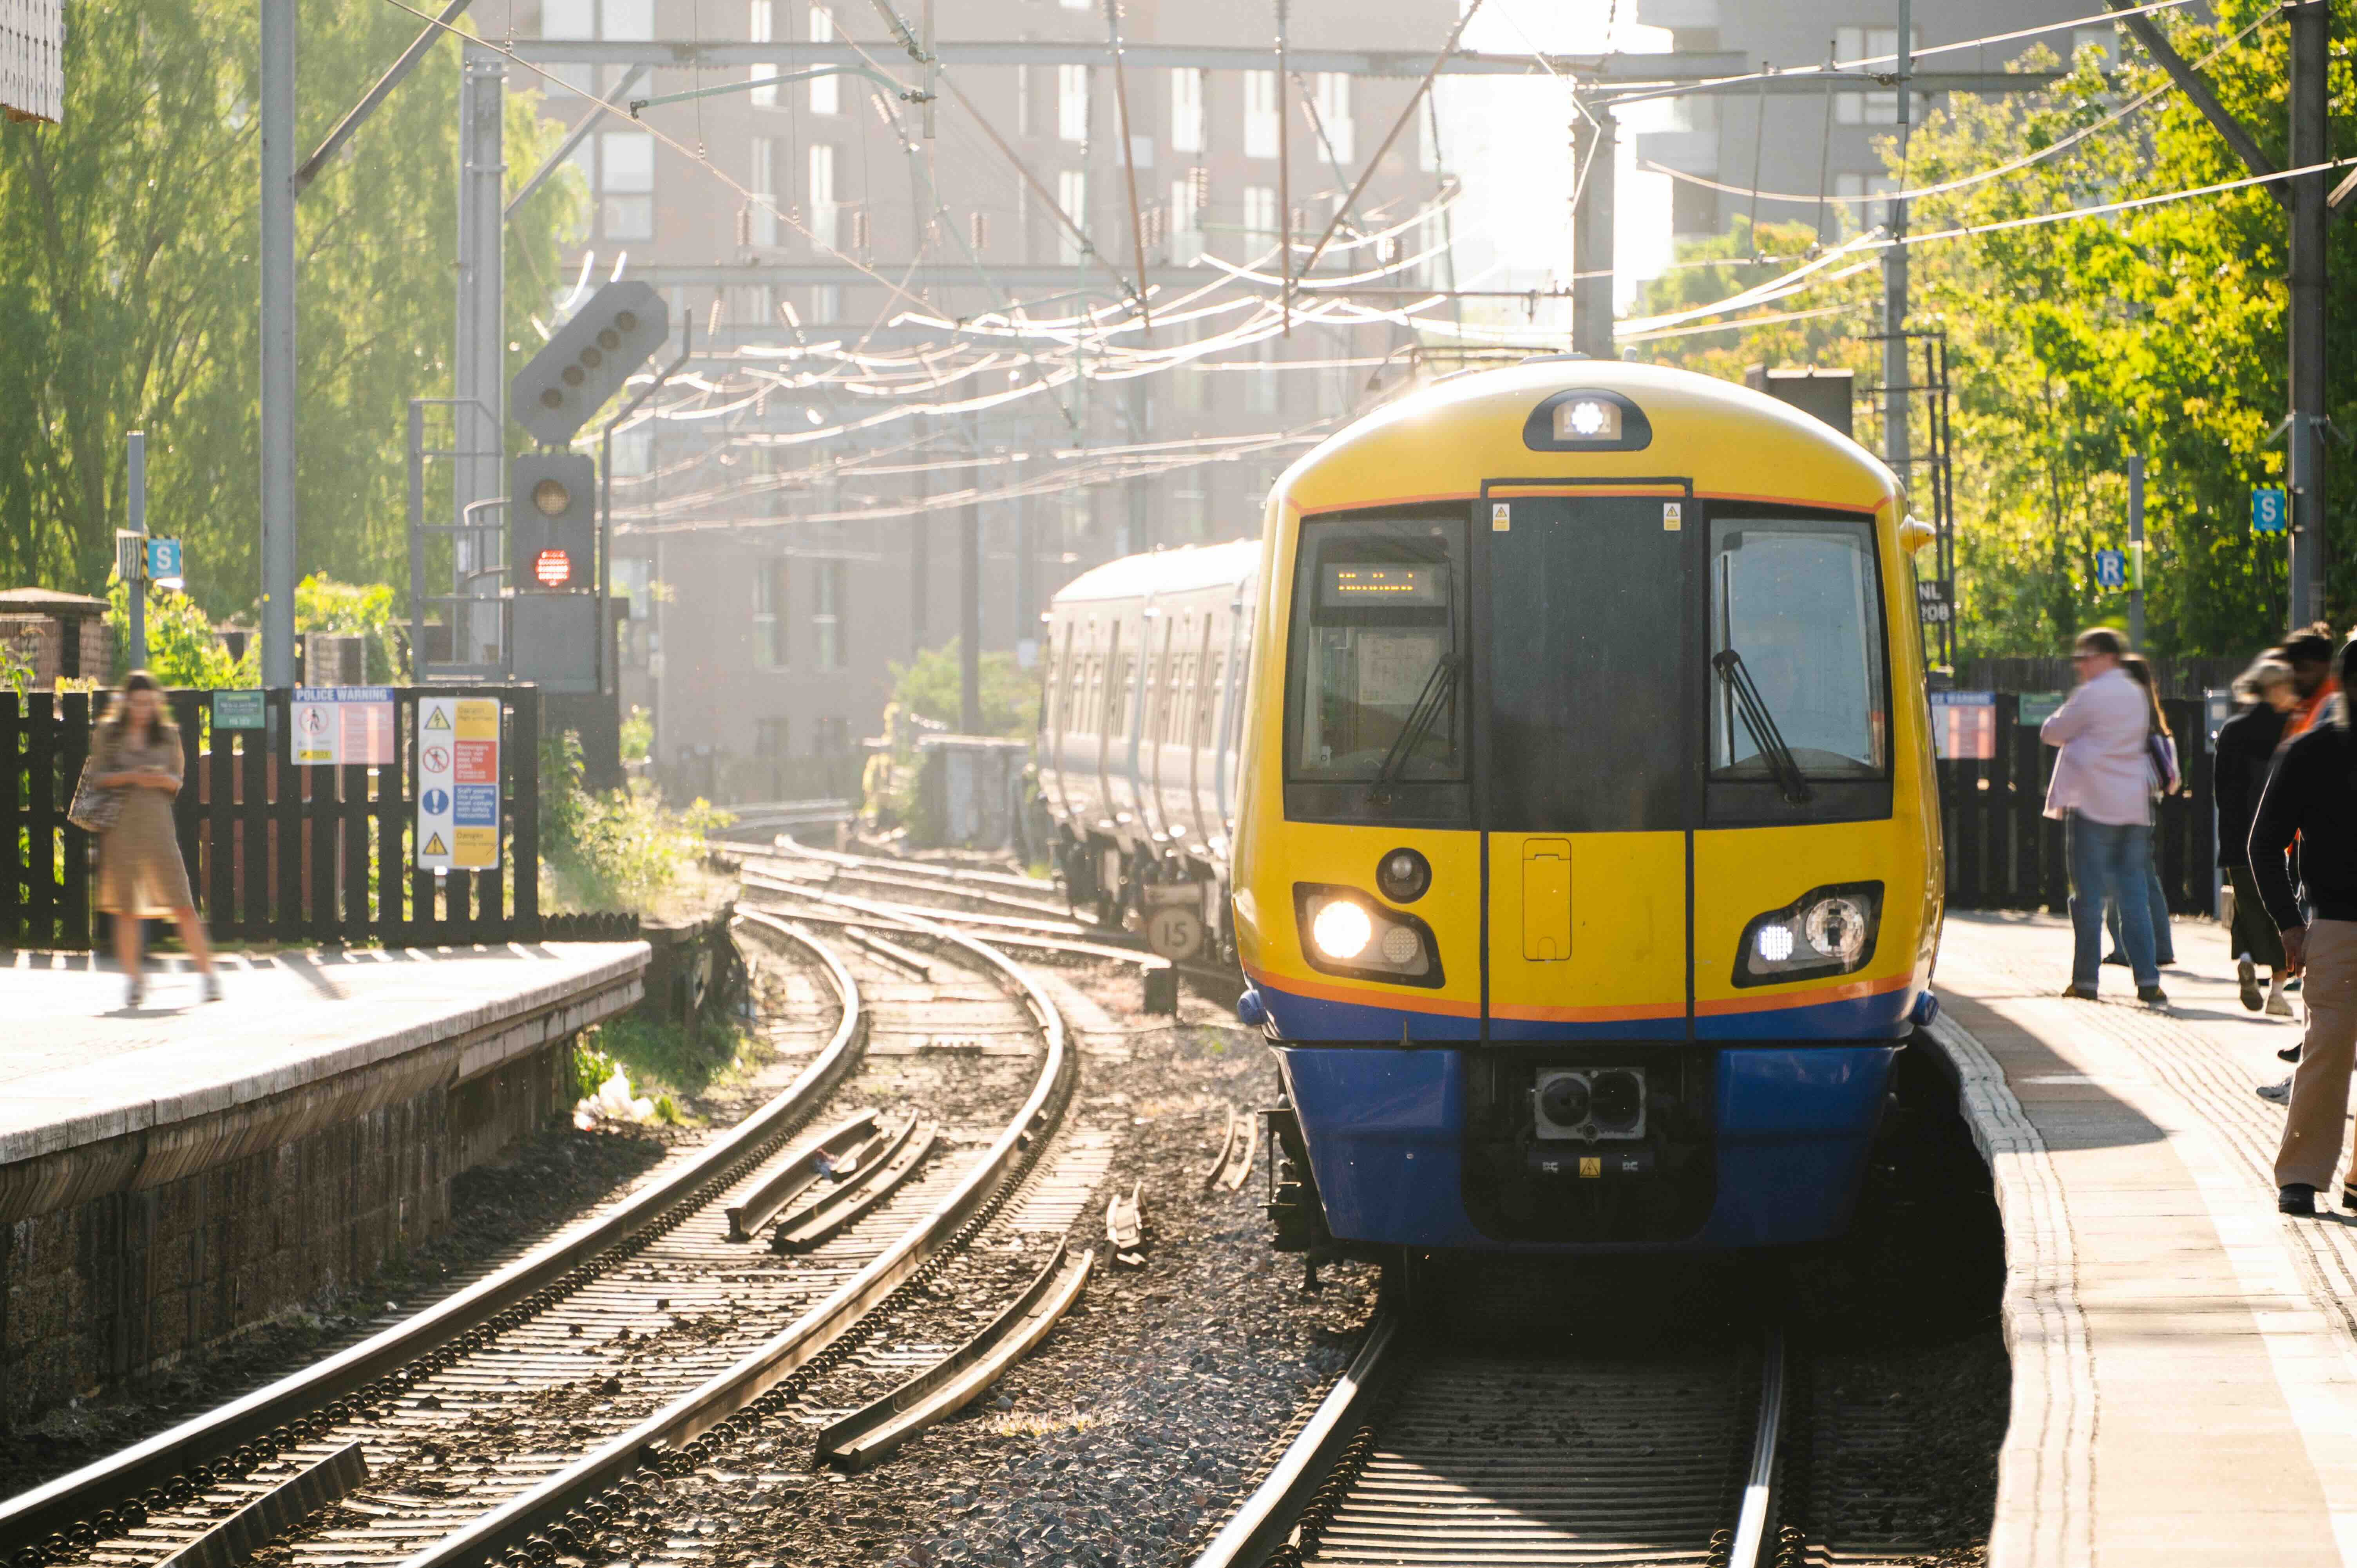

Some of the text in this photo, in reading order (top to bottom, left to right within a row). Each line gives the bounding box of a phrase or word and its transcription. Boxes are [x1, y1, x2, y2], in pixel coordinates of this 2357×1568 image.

[2261, 495, 2276, 523] S
[157, 545, 171, 570] S
[2103, 557, 2120, 581] R
[1919, 582, 1942, 600] NL
[296, 689, 387, 701] POLICE WARNING
[1164, 921, 1187, 947] 15
